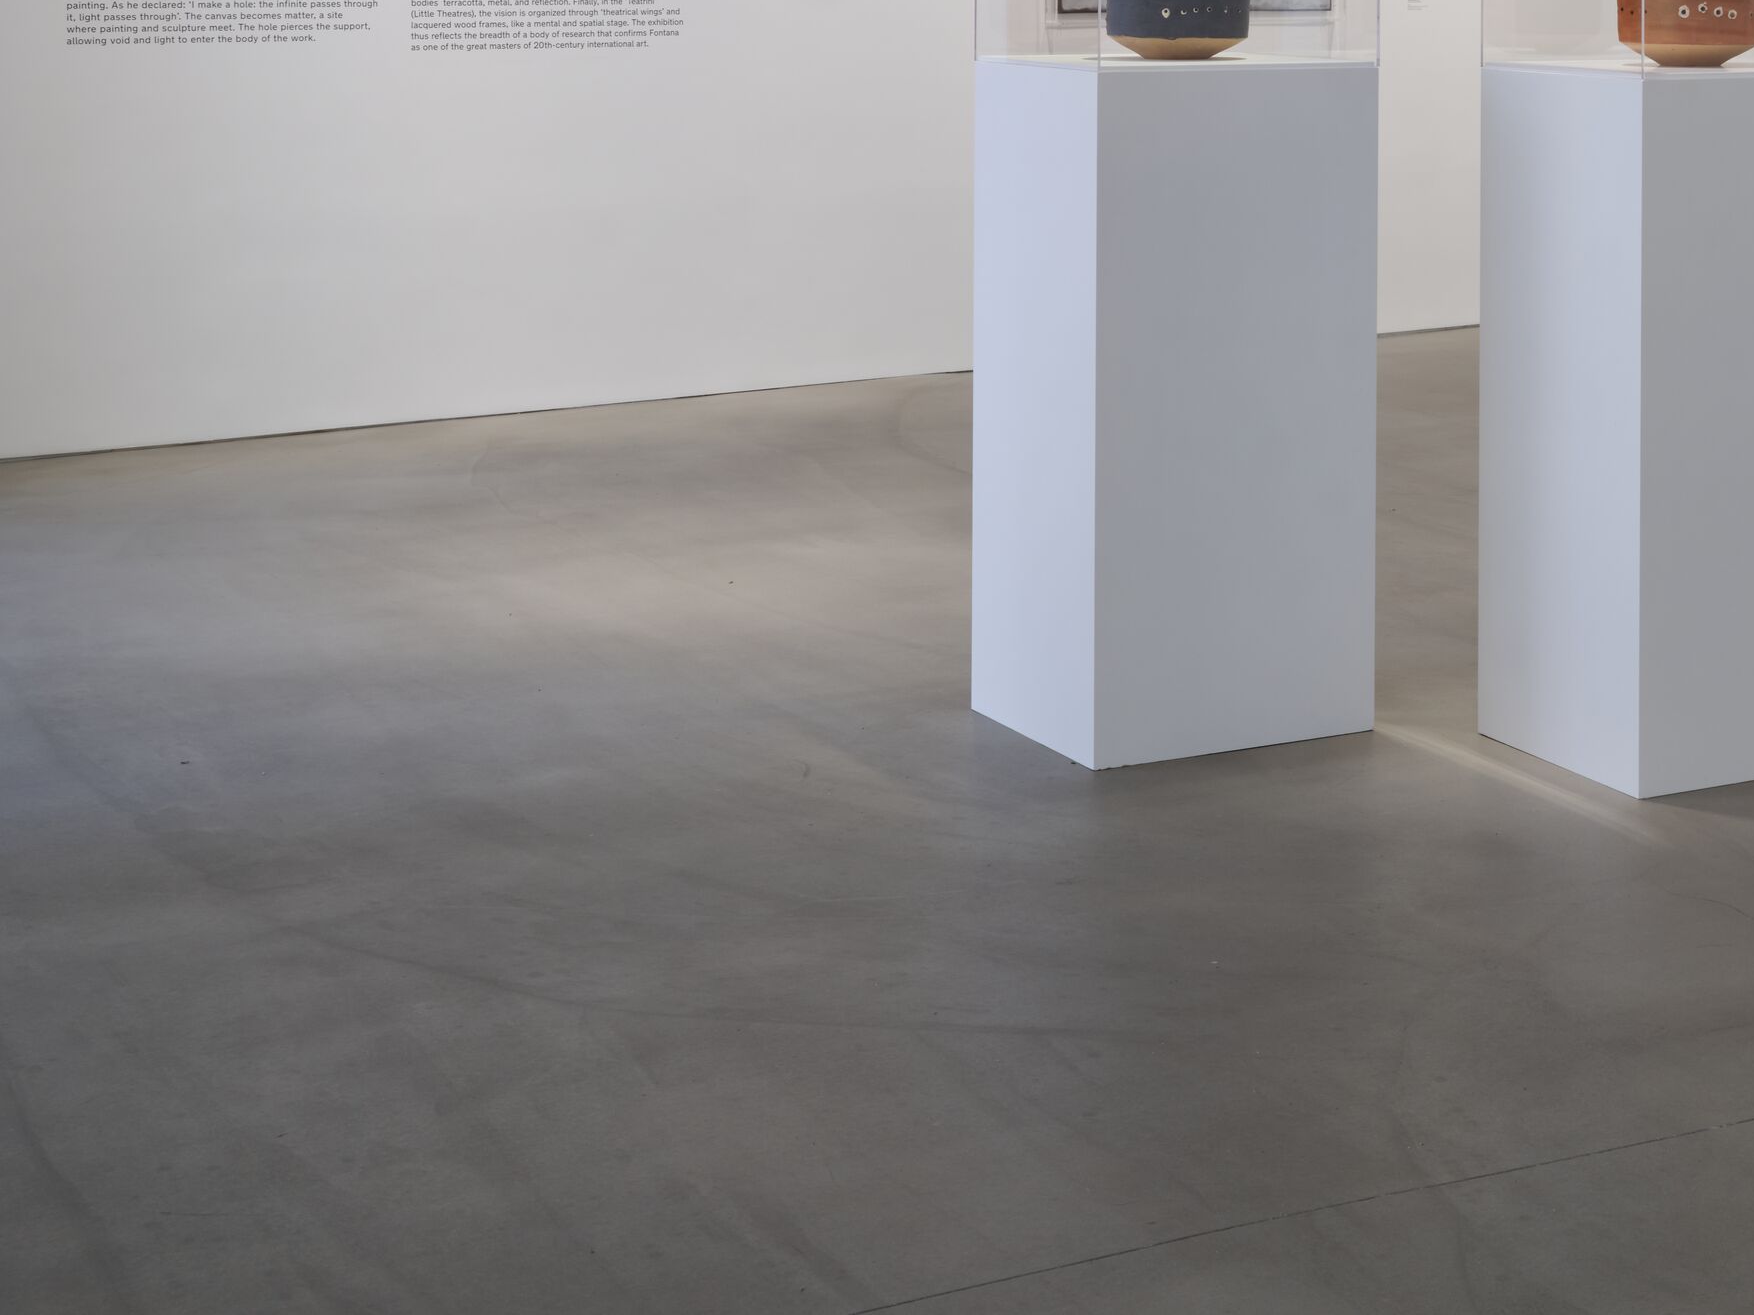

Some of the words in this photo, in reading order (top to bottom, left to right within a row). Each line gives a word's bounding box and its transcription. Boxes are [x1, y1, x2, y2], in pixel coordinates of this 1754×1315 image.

[66, 35, 106, 46] allowing
[110, 35, 130, 43] void
[133, 34, 151, 43] and
[154, 34, 174, 45] light
[178, 34, 187, 43] to
[190, 34, 214, 43] enter
[217, 33, 232, 42] the
[235, 33, 258, 44] body
[261, 33, 270, 42] of
[273, 33, 288, 41] the
[290, 32, 315, 41] work.
[410, 31, 428, 39] thus
[431, 30, 462, 39] reflects
[464, 30, 477, 39] the
[479, 29, 510, 38] breadth
[512, 29, 520, 38] of
[529, 29, 549, 40] body
[551, 29, 560, 37] of
[561, 28, 595, 37] research
[596, 28, 612, 37] that
[614, 27, 646, 36] confirms
[649, 27, 679, 36] Fontana
[440, 41, 448, 50] of
[450, 41, 464, 50] the
[466, 41, 486, 52] great
[489, 40, 521, 49] masters
[523, 40, 531, 49] of
[586, 38, 634, 48] international
